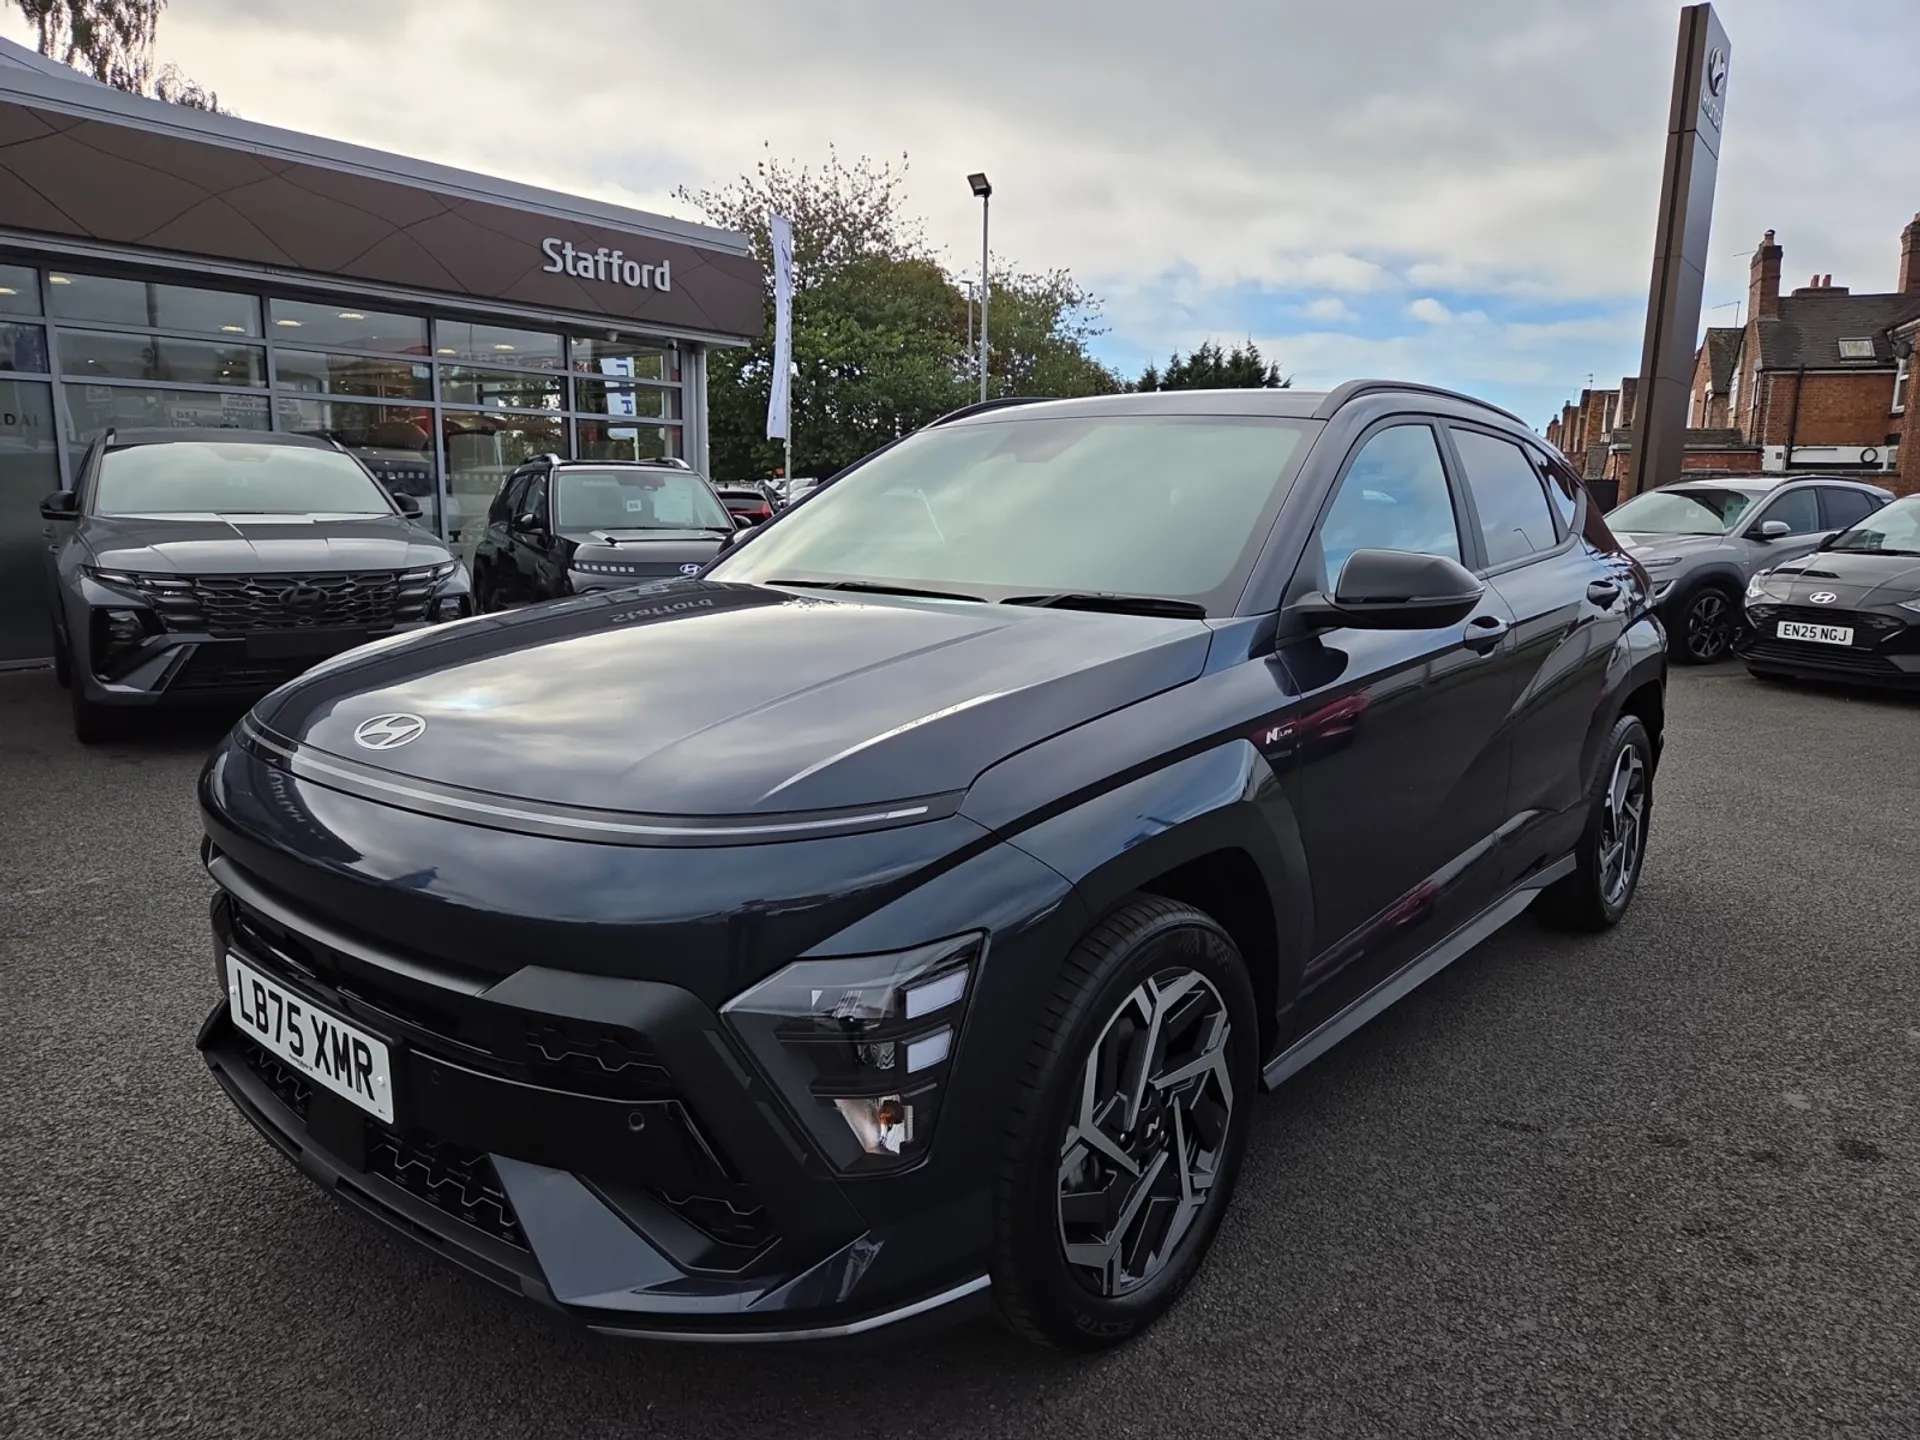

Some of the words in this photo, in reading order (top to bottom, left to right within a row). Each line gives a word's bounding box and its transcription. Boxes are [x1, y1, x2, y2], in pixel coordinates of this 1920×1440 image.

[542, 237, 671, 292] Stafford
[1783, 623, 1817, 639] EN25
[1820, 627, 1848, 641] NGJ
[237, 968, 304, 1058] LB75
[310, 1014, 376, 1101] XMR
